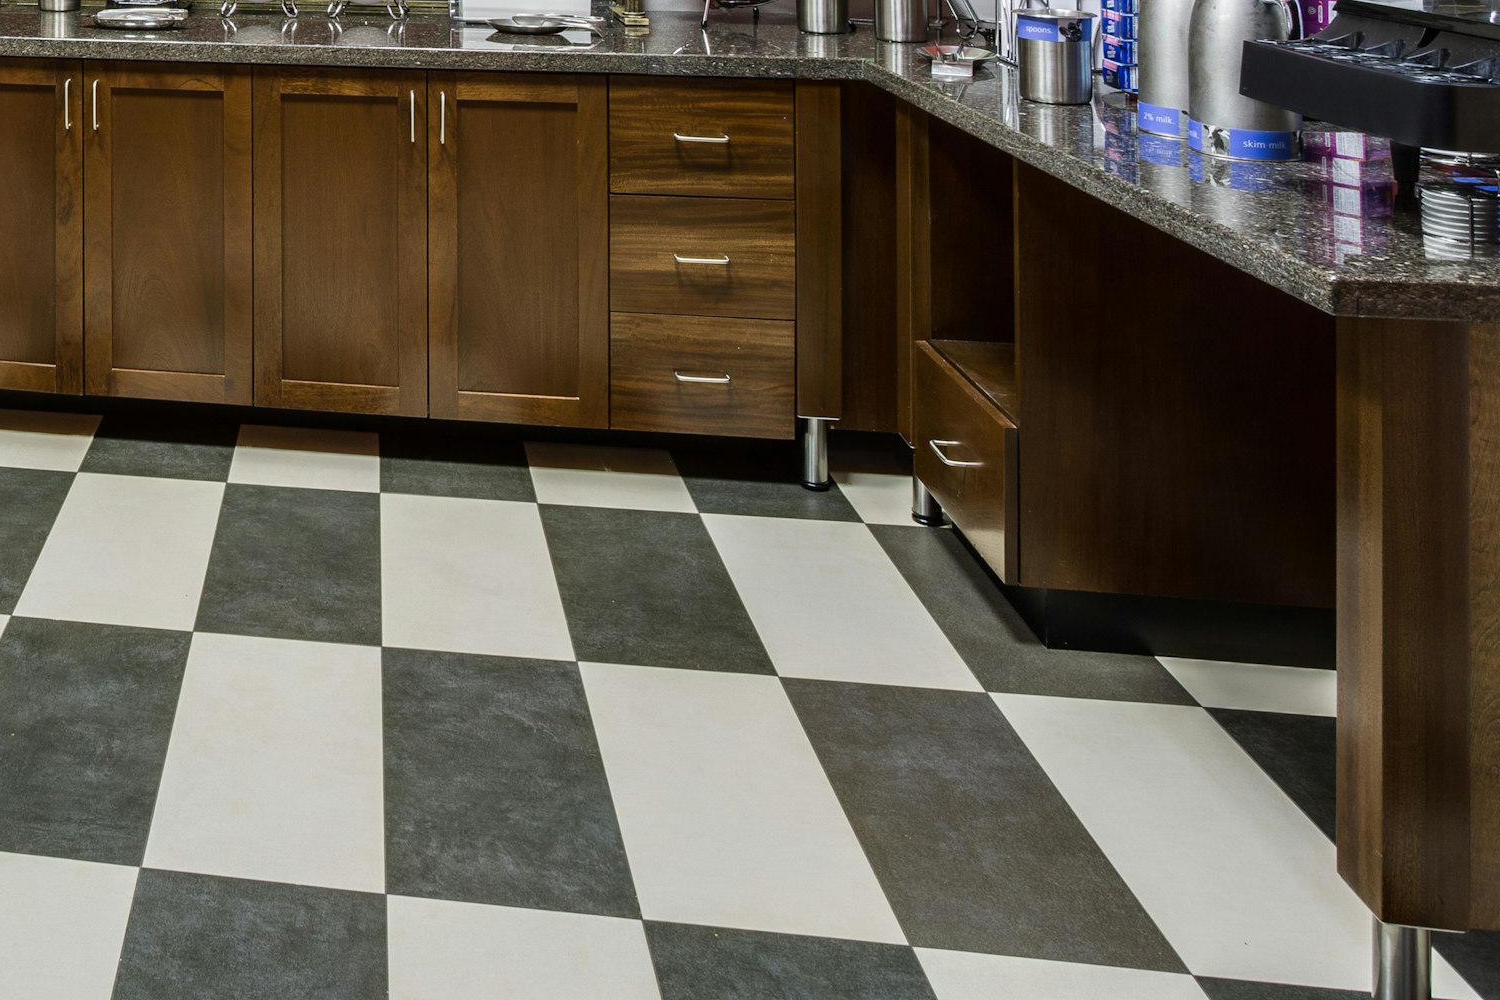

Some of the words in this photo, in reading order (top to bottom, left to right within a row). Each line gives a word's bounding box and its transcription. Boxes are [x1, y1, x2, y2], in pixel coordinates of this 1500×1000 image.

[1025, 26, 1053, 34] spoons.
[1143, 111, 1154, 121] 2%
[1155, 114, 1175, 124] milk.
[1242, 139, 1266, 149] skim
